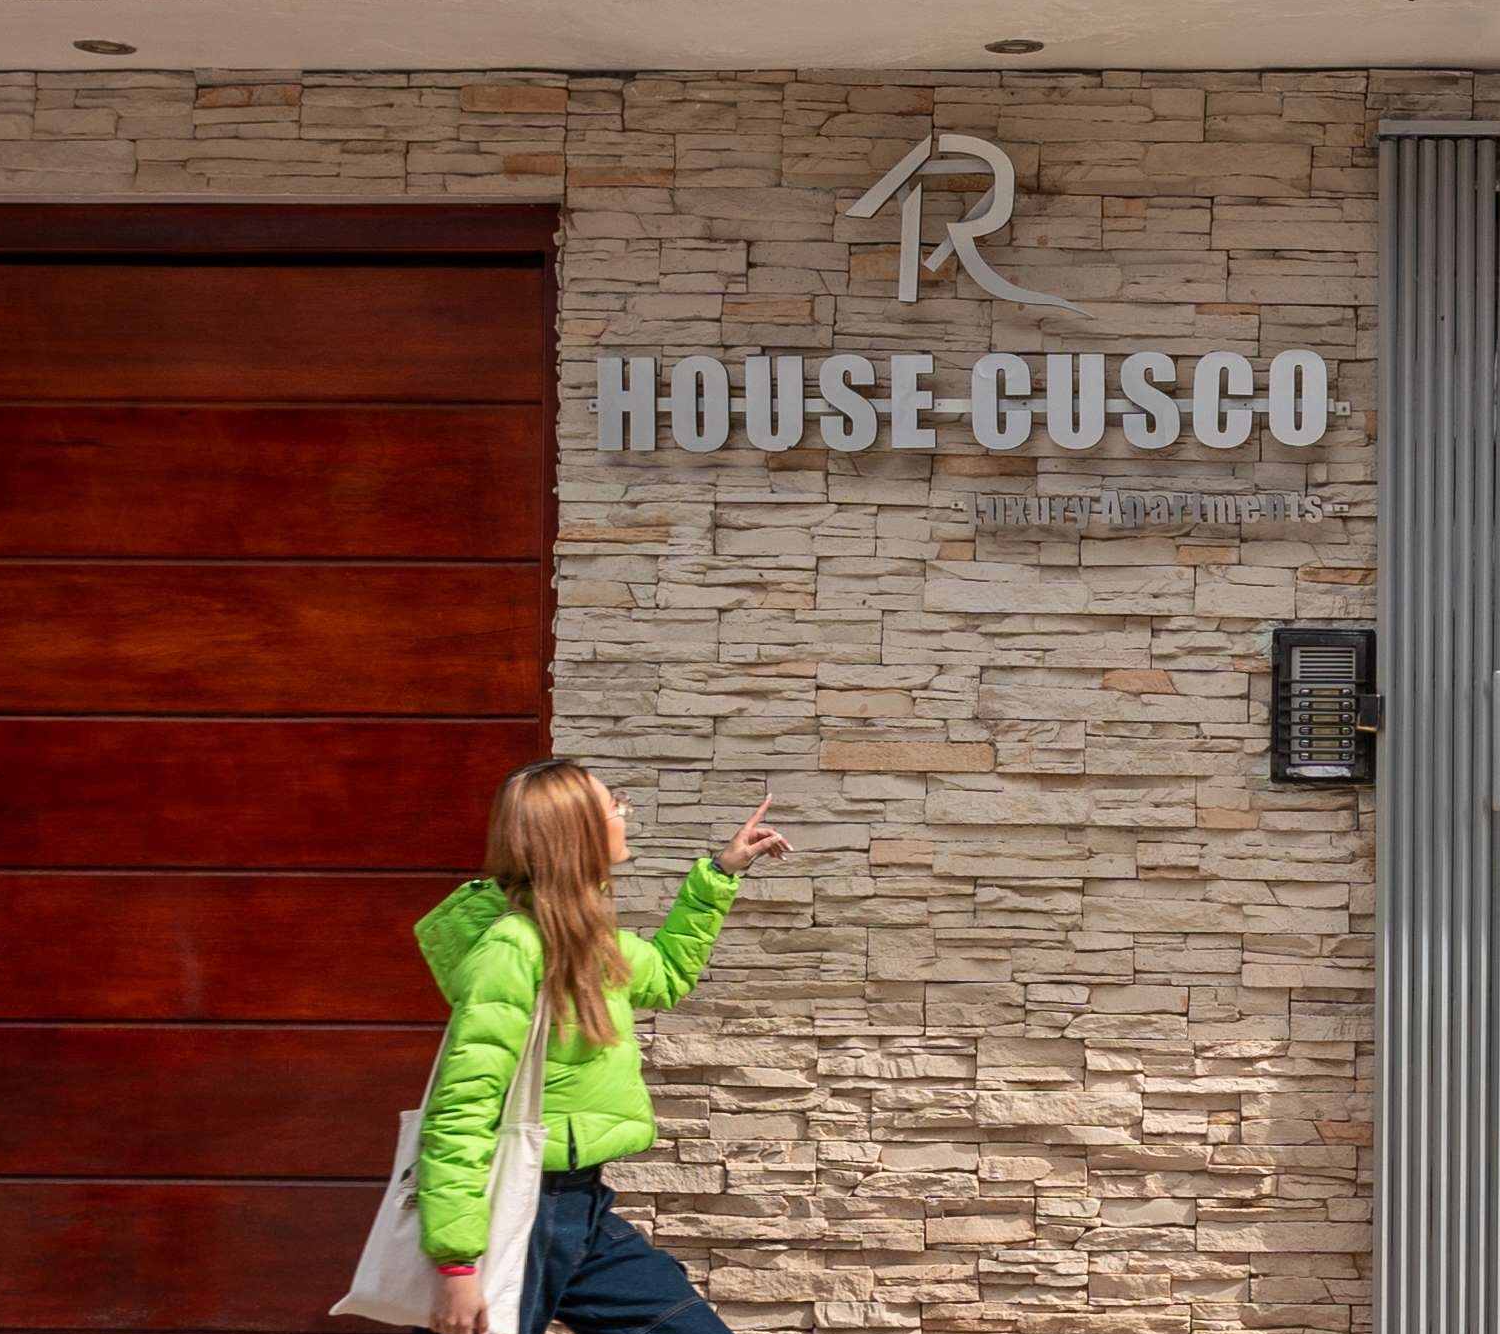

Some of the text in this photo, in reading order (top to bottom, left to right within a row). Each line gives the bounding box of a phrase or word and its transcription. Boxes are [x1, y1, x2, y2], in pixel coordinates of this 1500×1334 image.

[596, 349, 1328, 453] HOUSE CUSCO
[968, 489, 1324, 529] Luxury Apartments
